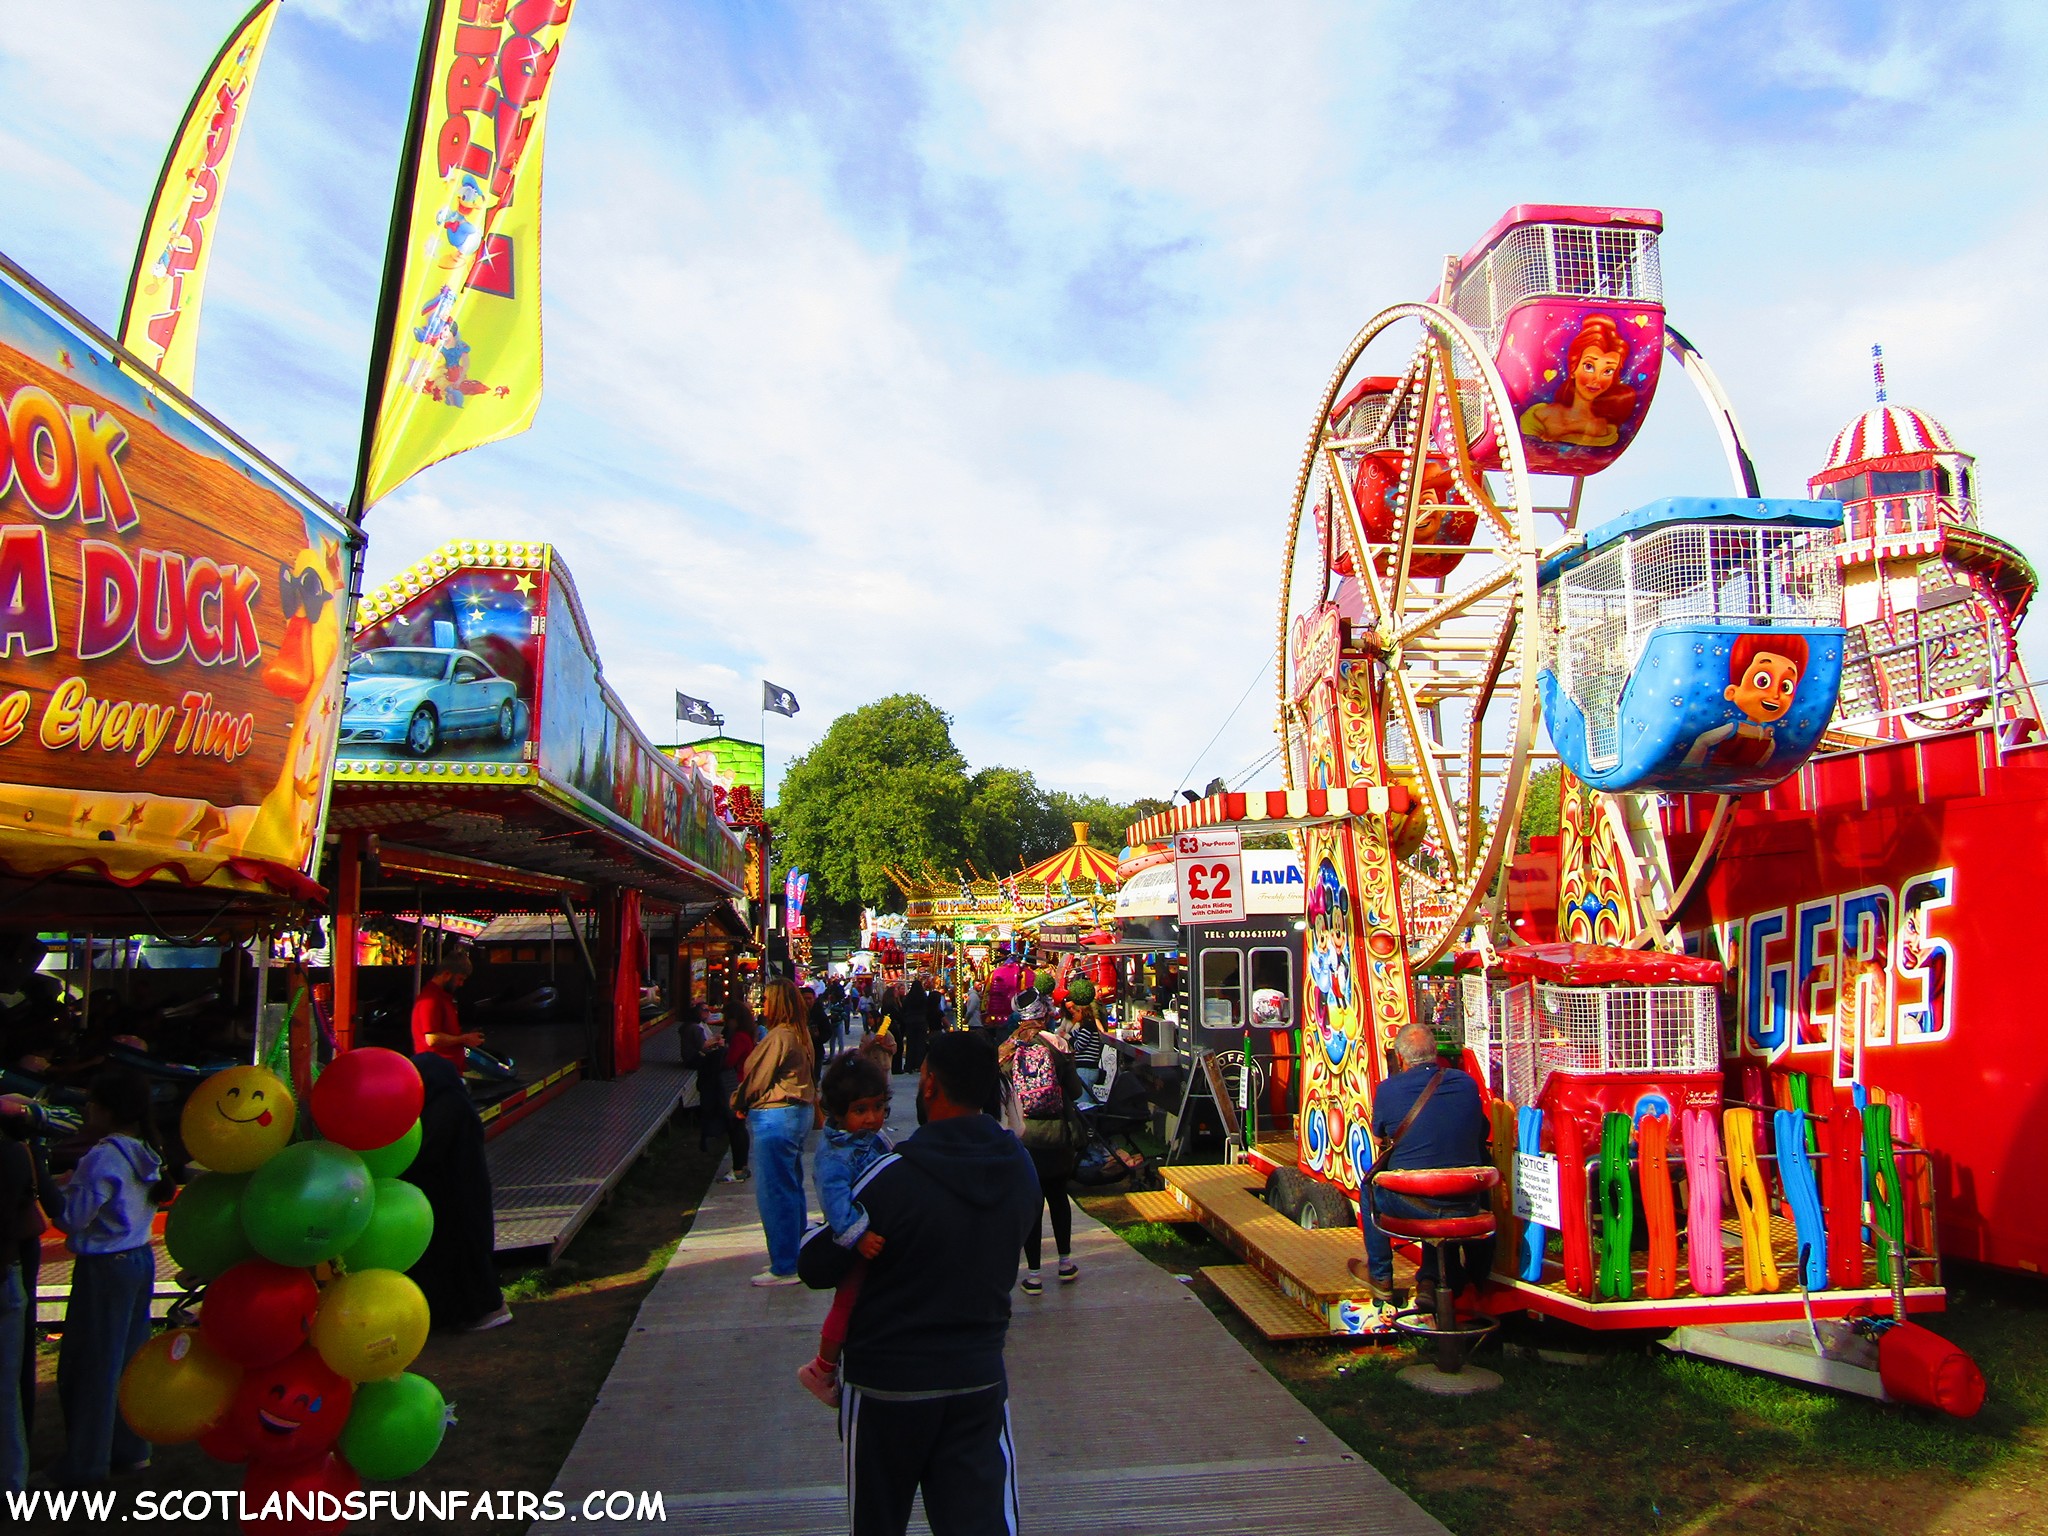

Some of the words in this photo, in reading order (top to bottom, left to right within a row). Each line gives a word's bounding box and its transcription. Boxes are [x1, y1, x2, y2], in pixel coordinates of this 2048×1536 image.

[166, 76, 249, 277] DUCK
[0, 385, 139, 533] OK
[0, 525, 57, 658] A
[77, 538, 262, 669] DUCK
[39, 676, 172, 769] Every
[174, 690, 254, 763] Time
[1178, 836, 1199, 854] £3
[1188, 863, 1232, 900] £2
[1212, 902, 1232, 910] Riding
[1684, 866, 1955, 1087] NGERS
[1517, 1155, 1549, 1172] NOTICE
[1524, 1172, 1540, 1182] Notes
[1525, 1181, 1549, 1193] Checked
[1536, 1202, 1543, 1210] be
[1539, 1194, 1552, 1203] Fake
